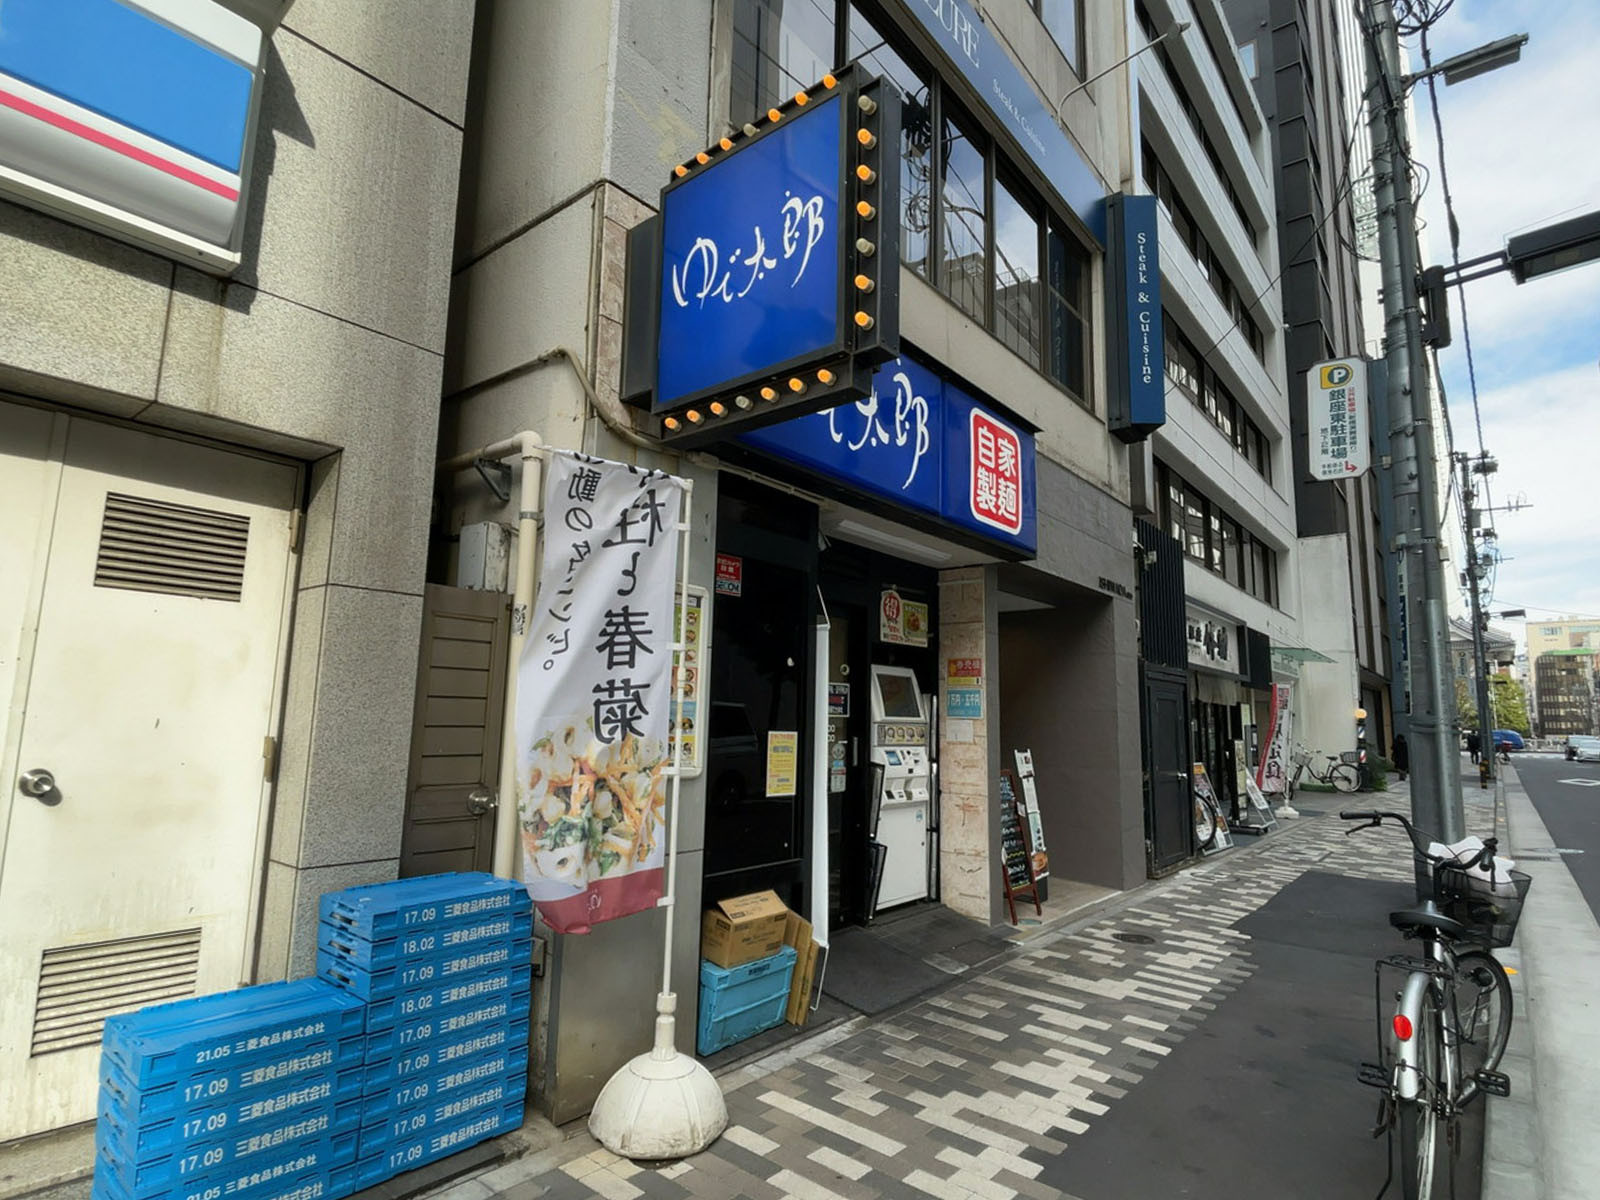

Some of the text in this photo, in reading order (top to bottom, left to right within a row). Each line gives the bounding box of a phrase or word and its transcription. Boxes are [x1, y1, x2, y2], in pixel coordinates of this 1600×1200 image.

[1136, 232, 1151, 384] Steak & Cuisine
[1329, 388, 1348, 459] 銀座東駐車場
[404, 894, 511, 925] 17.09 三菱食品株式会社
[403, 921, 510, 954] 18.02 三菱食品株式会社
[402, 949, 509, 984] 17.09 三菱食品株式会社
[401, 976, 508, 1014] 18.02 三菱食品株式会社
[196, 1022, 325, 1064] 21.05 三菱食品株式会社
[400, 1003, 507, 1044] 17.09 三菱食品株式会社
[398, 1031, 505, 1074] 17.09 三菱食品株式会社
[184, 1050, 333, 1102] 17.09 三菱食品株式会社
[396, 1058, 504, 1105] 17.09 三菱食品株式会社
[183, 1082, 331, 1138] 17.09 三菱食品株式会社
[394, 1086, 503, 1136] 17.09 三菱食品株式会社
[179, 1115, 329, 1174] 17.09 三菱食品株式会社
[390, 1115, 499, 1168] 17.09 三菱食品株式会社
[224, 1154, 317, 1195] 三菱食品株式会社
